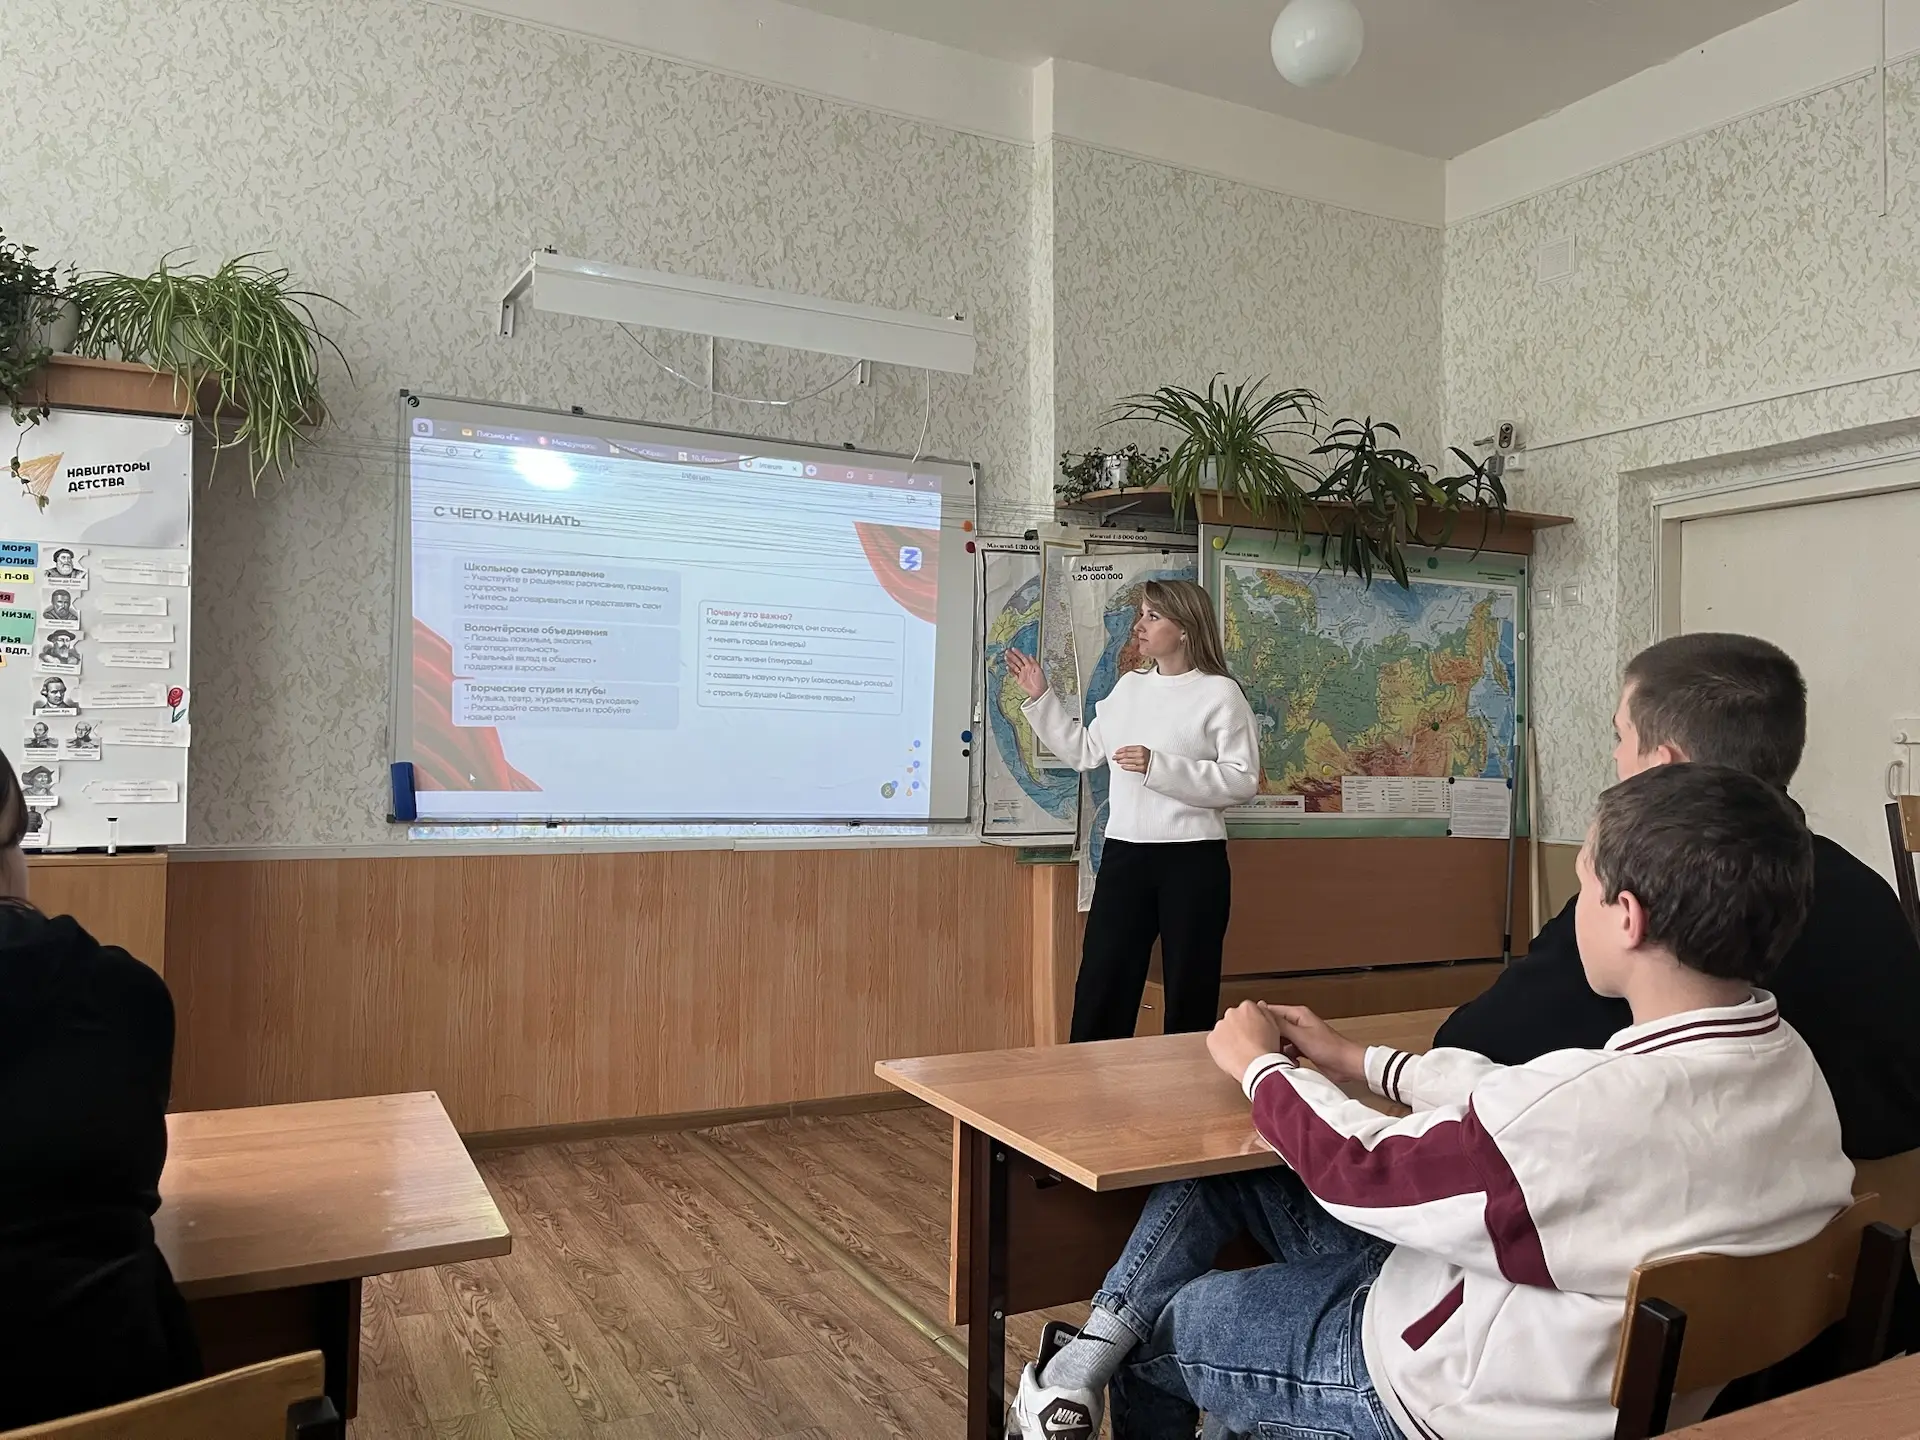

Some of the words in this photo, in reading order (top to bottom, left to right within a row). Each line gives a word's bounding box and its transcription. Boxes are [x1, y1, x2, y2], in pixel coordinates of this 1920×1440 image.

[67, 462, 150, 478] НАВИГАТОРЫ
[68, 477, 125, 492] ДЕТСТВА
[433, 506, 445, 517] С
[450, 507, 493, 520] ЧЕГО
[498, 510, 581, 527] НАЧИНАТЬ
[1, 544, 31, 552] МОРЯ
[464, 562, 519, 573] Школьное
[521, 567, 605, 578] самоуправление
[1080, 564, 1113, 572] Масштаб
[4, 573, 29, 581] П-ОВ
[471, 573, 520, 584] Участвуйте
[464, 584, 519, 593] соцпроекты
[471, 592, 507, 602] Учитесь
[509, 595, 577, 605] договариваться
[585, 599, 641, 609] представлять
[464, 604, 508, 612] интересы
[1, 610, 34, 620] НИЗМ.
[706, 607, 741, 619] Почему
[743, 611, 758, 619] это
[760, 612, 793, 621] важно?
[706, 617, 728, 626] Когда
[464, 623, 539, 635] Волонтёрские
[541, 626, 608, 637] объединения
[471, 634, 509, 643] Помощь
[742, 638, 768, 646] города
[5, 646, 30, 655] ВДП.
[464, 643, 559, 653] благотворительность
[471, 653, 514, 661] Реальный
[464, 664, 513, 672] поддержка
[464, 683, 526, 693] Творческие
[528, 686, 565, 694] студии
[575, 686, 607, 696] клубы
[712, 689, 743, 697] строить
[471, 703, 527, 712] Раскрывайте
[592, 706, 631, 715] пробуйте
[493, 714, 516, 722] роли
[1053, 1407, 1084, 1425] NIKE
